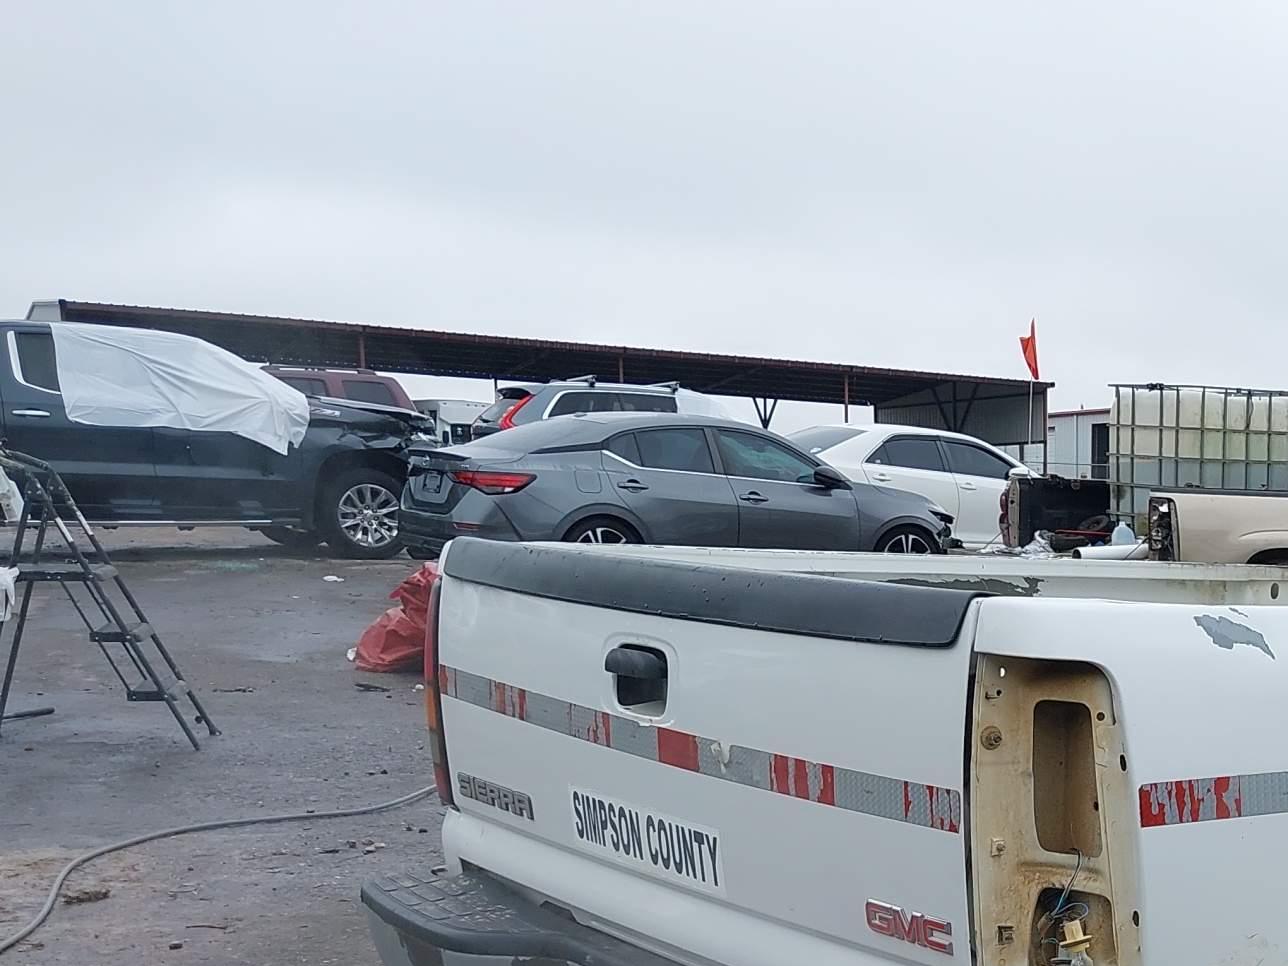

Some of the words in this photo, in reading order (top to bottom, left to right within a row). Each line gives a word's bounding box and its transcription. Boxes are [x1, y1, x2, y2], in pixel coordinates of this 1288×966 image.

[457, 772, 535, 821] SIERRA
[572, 791, 644, 860] SIMPSON
[646, 815, 719, 887] COUNTY
[865, 898, 954, 956] GMC
